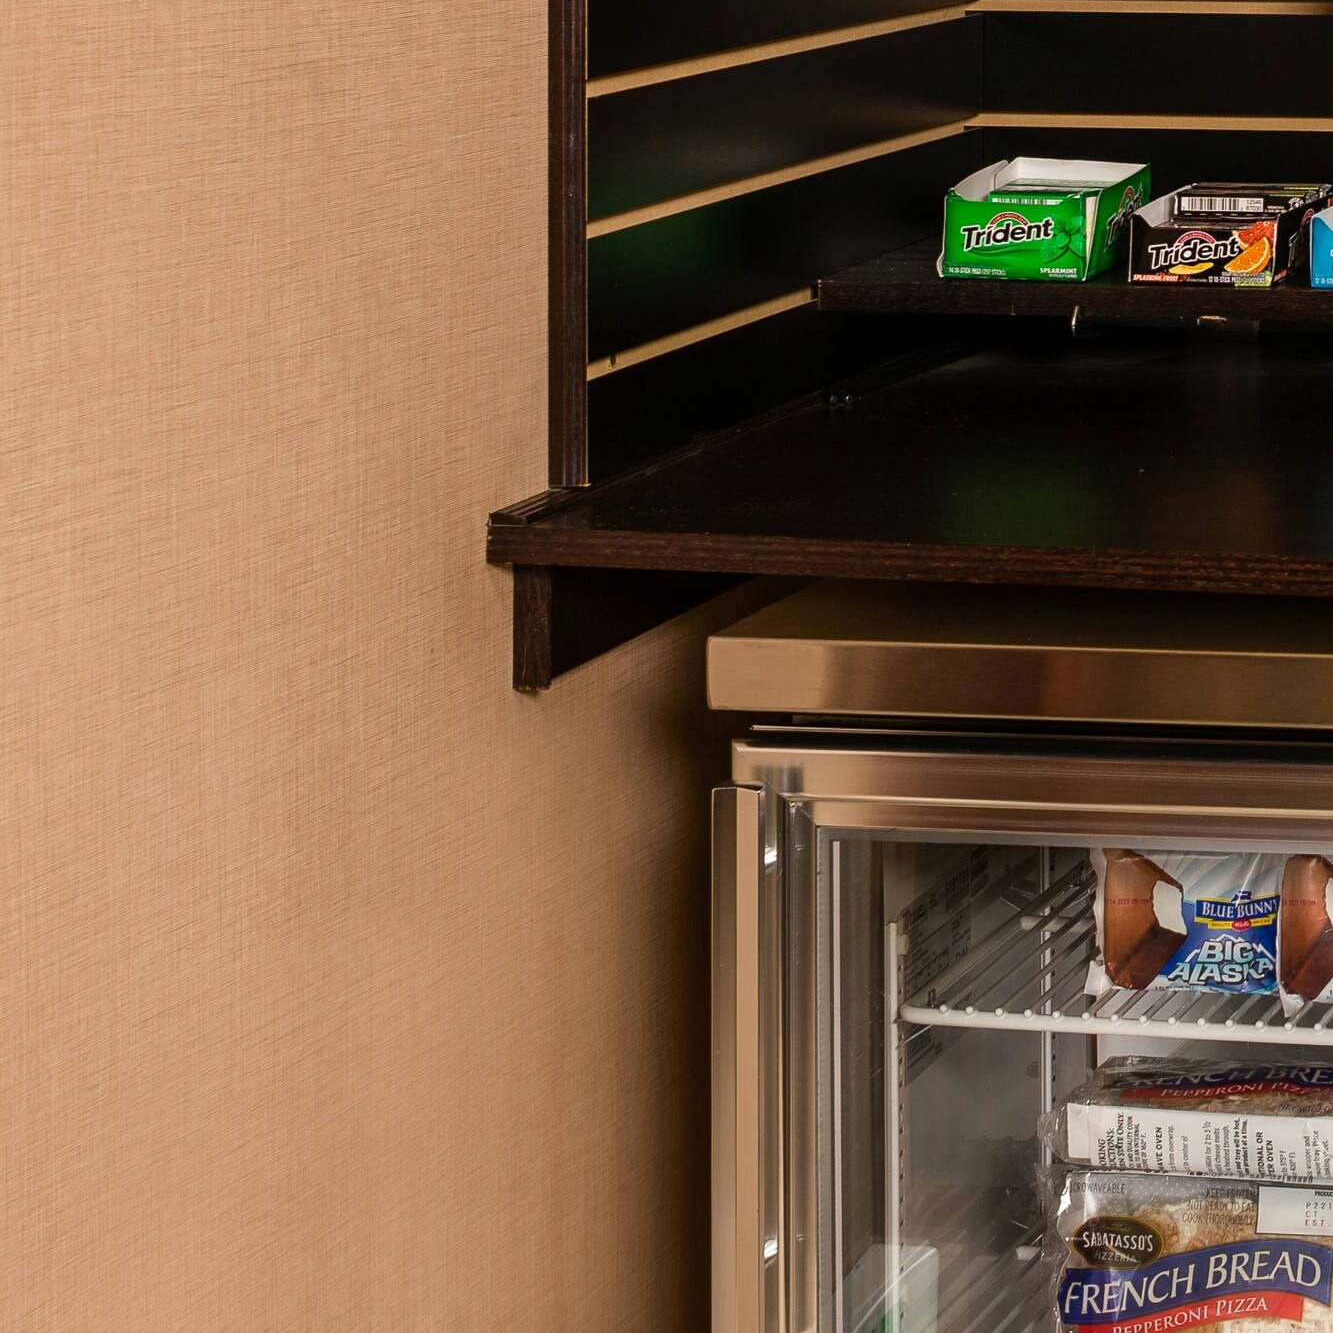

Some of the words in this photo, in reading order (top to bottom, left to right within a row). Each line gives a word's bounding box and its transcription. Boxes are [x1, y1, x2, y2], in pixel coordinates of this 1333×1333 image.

[962, 217, 1053, 251] Trident
[1150, 237, 1240, 269] Trident
[1202, 903, 1234, 917] BLUE
[1236, 900, 1279, 916] BUNNY
[1201, 941, 1253, 963] BIG
[1169, 958, 1274, 985] ALASKA
[1083, 1232, 1153, 1251] SABATASSO'S
[1064, 1263, 1196, 1315] FRENCH
[1206, 1250, 1322, 1290] BREAD
[1216, 1297, 1267, 1316] PIZZA
